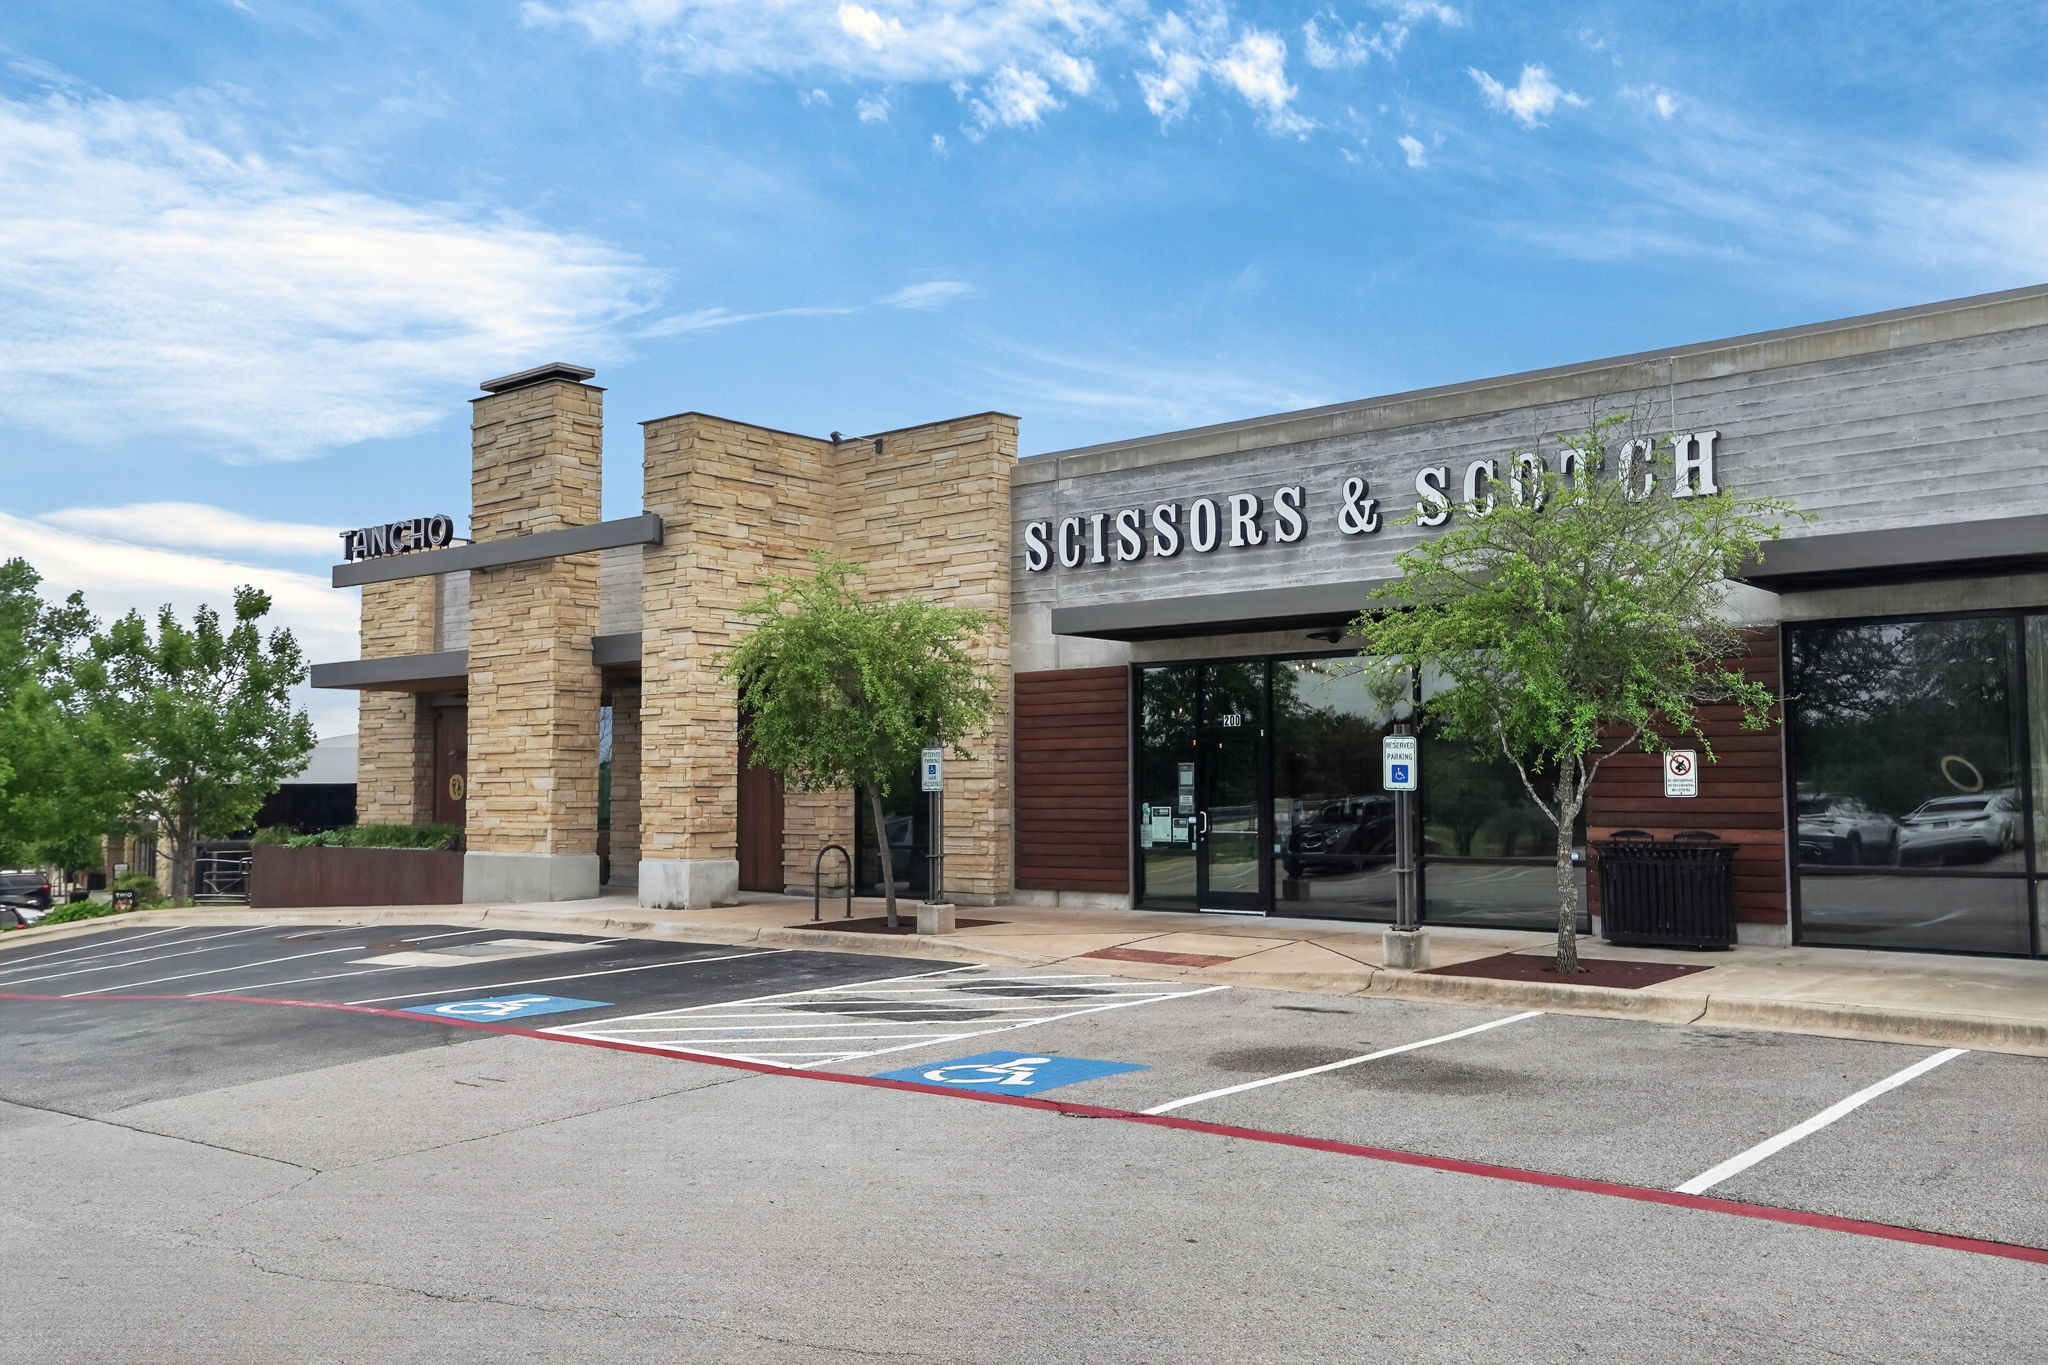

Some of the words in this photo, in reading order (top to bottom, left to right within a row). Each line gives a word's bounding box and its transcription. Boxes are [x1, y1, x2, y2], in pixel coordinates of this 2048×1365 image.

[1024, 486, 1308, 572] SCISSORS
[1337, 476, 1383, 536] &
[339, 514, 454, 560] TANCHO
[1224, 715, 1241, 726] 200
[1385, 741, 1414, 750] RESERVED
[1387, 752, 1413, 761] PARKING
